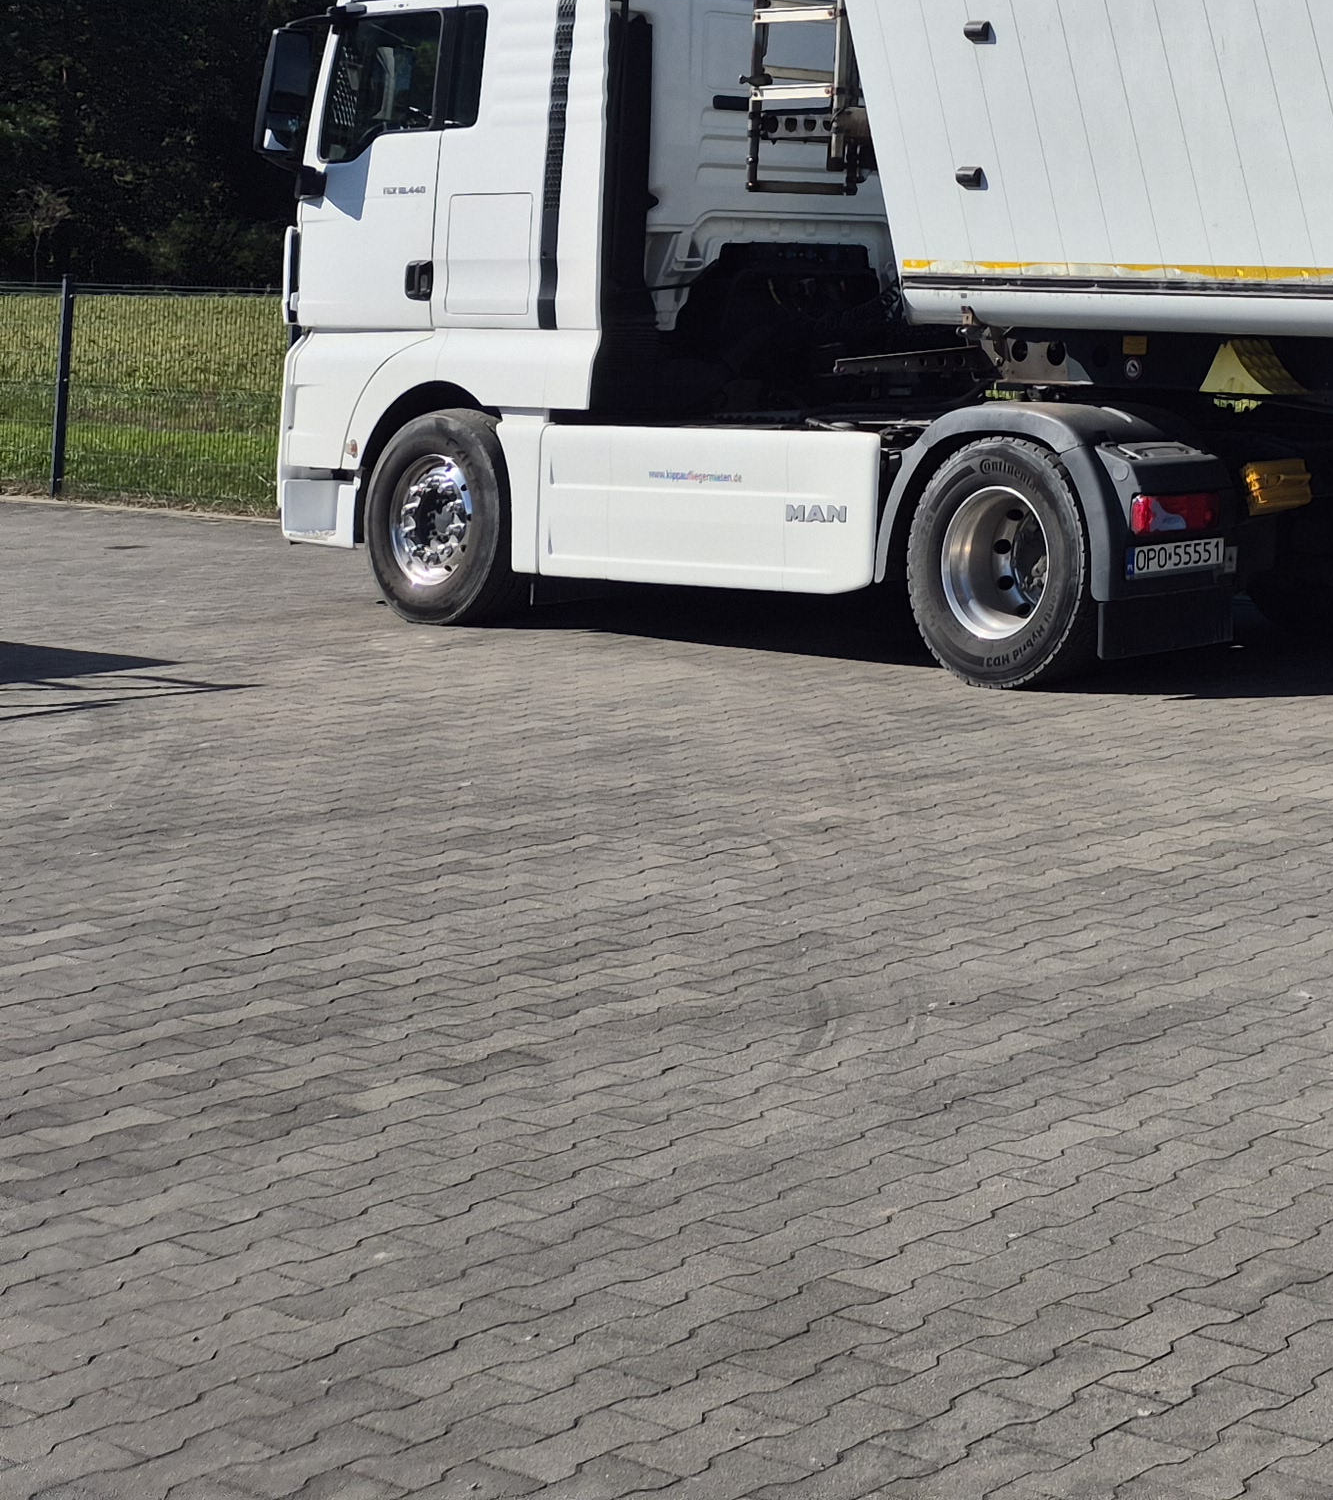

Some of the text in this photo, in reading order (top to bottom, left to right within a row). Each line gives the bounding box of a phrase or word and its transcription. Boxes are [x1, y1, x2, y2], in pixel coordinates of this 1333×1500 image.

[785, 504, 848, 523] MAN
[1135, 541, 1220, 571] OPO 55551
[1012, 625, 1047, 660] Hybrid
[985, 653, 1011, 668] HD3
